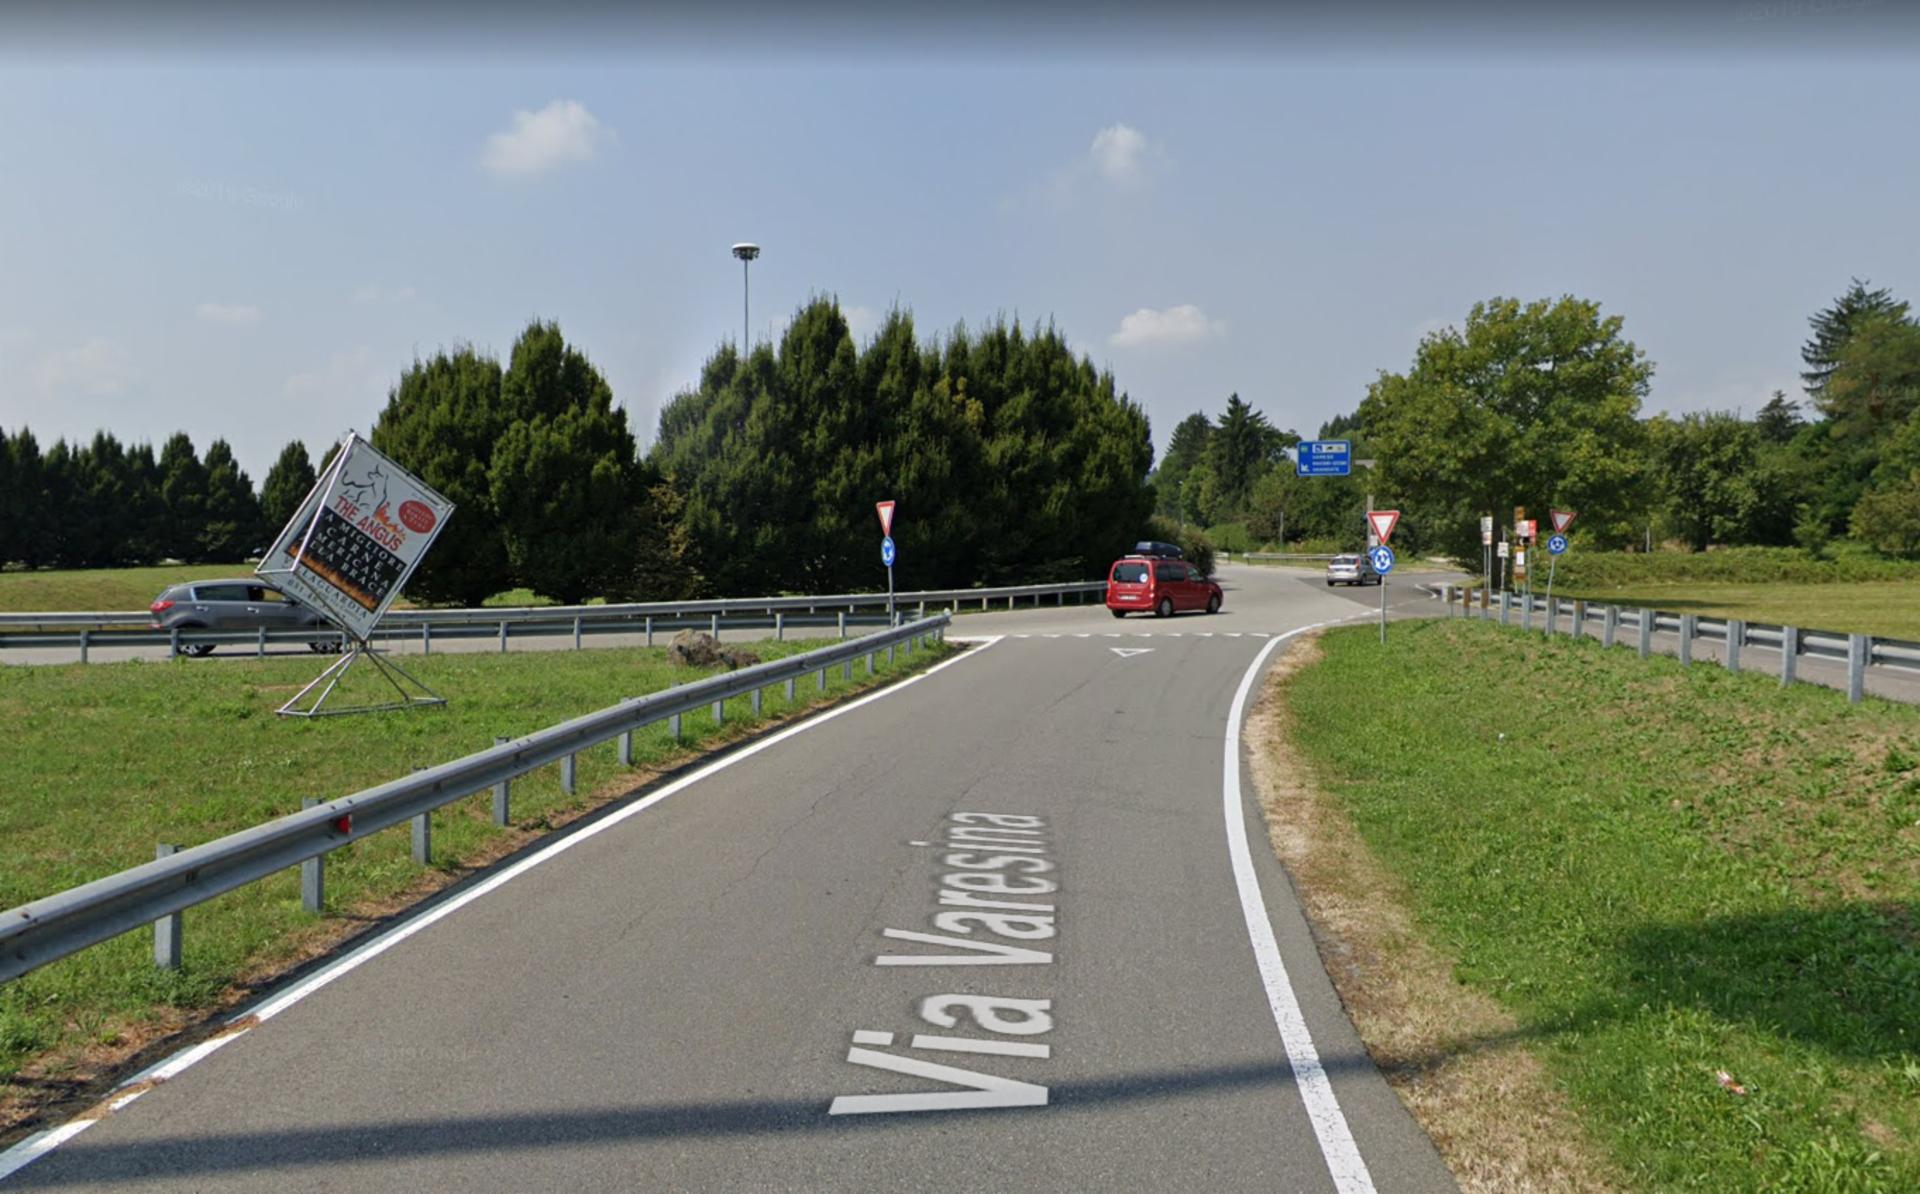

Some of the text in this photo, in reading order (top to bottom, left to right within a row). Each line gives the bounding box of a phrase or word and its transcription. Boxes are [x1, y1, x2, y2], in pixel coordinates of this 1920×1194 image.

[326, 526, 384, 571] CARNE
[334, 495, 360, 523] THE
[356, 515, 403, 552] ANGUS
[339, 522, 403, 572] MIGLIORE
[302, 527, 389, 588] MERICANA
[341, 562, 385, 597] BRACE
[828, 812, 1057, 1116] Via Varesina
